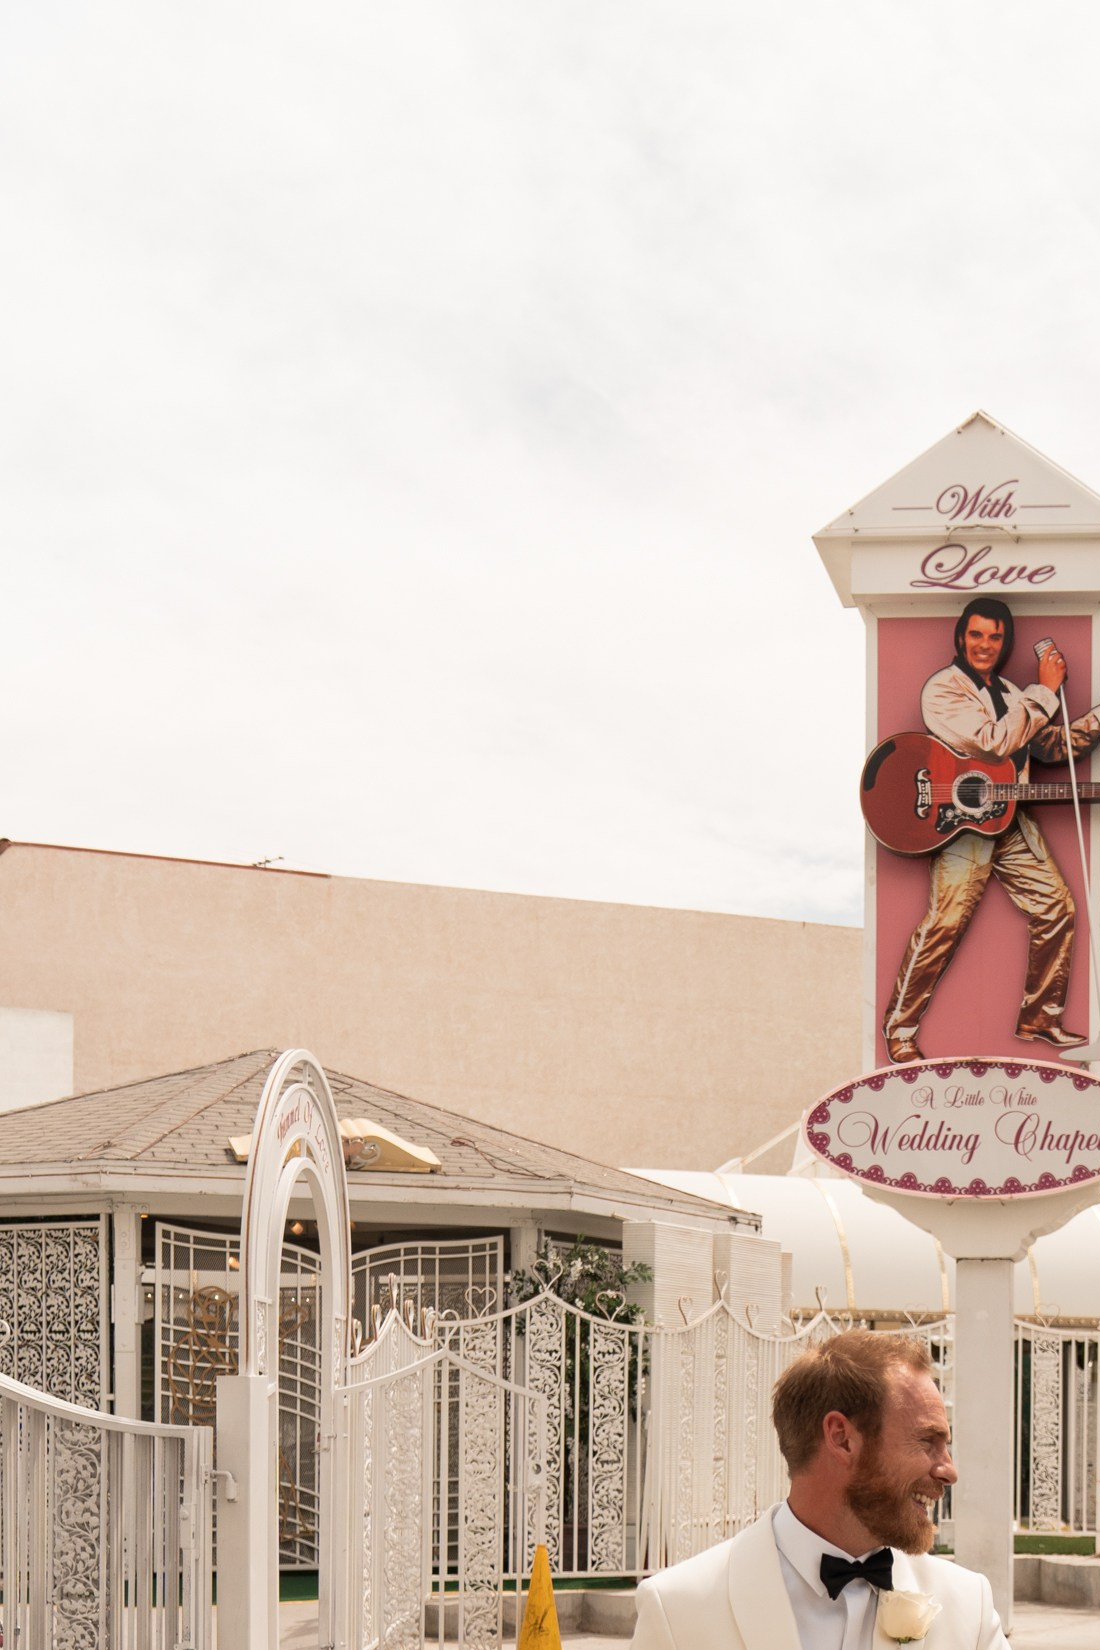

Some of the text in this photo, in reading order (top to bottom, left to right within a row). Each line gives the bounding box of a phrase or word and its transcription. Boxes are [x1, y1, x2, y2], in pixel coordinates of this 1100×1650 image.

[935, 479, 1019, 521] With
[910, 543, 1057, 591] Love
[910, 1086, 1038, 1109] A Little White
[837, 1110, 981, 1165] Wedding
